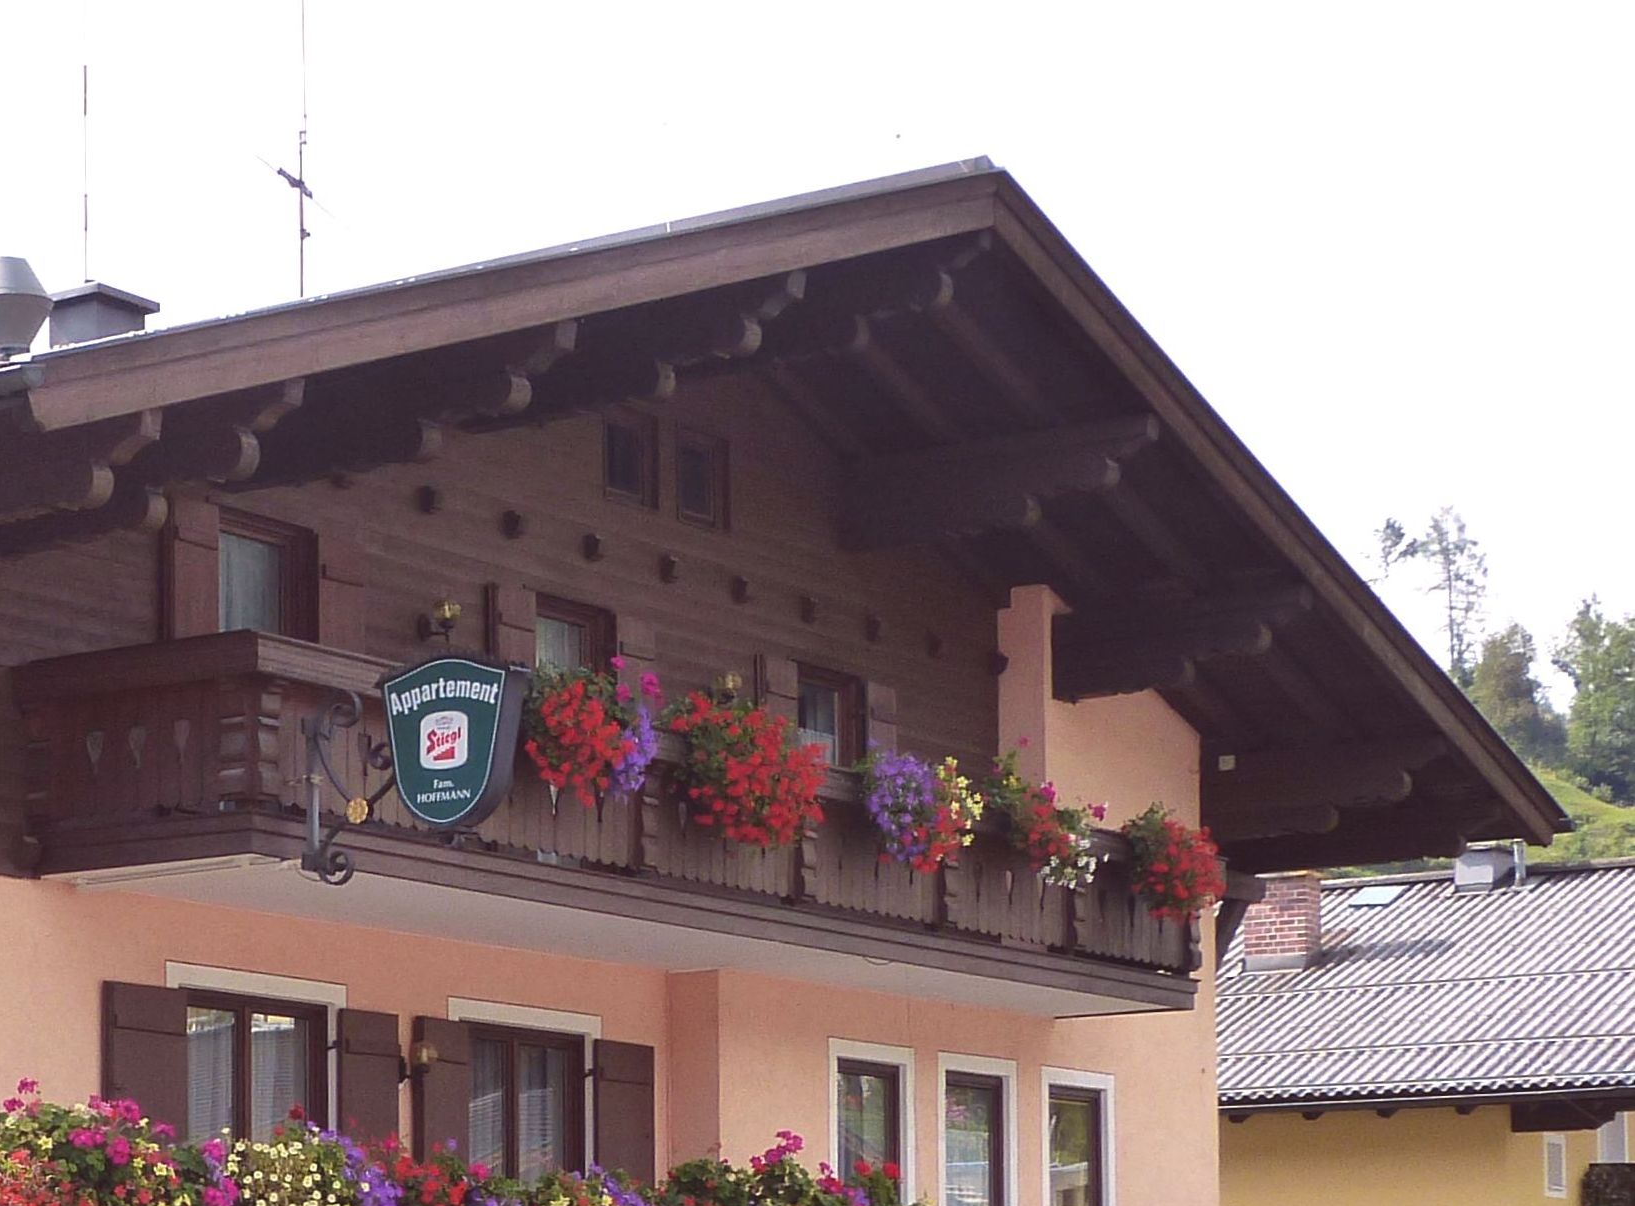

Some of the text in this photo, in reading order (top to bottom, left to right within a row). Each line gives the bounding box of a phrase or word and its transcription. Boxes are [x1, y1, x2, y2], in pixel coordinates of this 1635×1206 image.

[390, 678, 499, 715] Appartement
[426, 727, 461, 755] Stiegl
[417, 789, 470, 803] HOFFMANN
